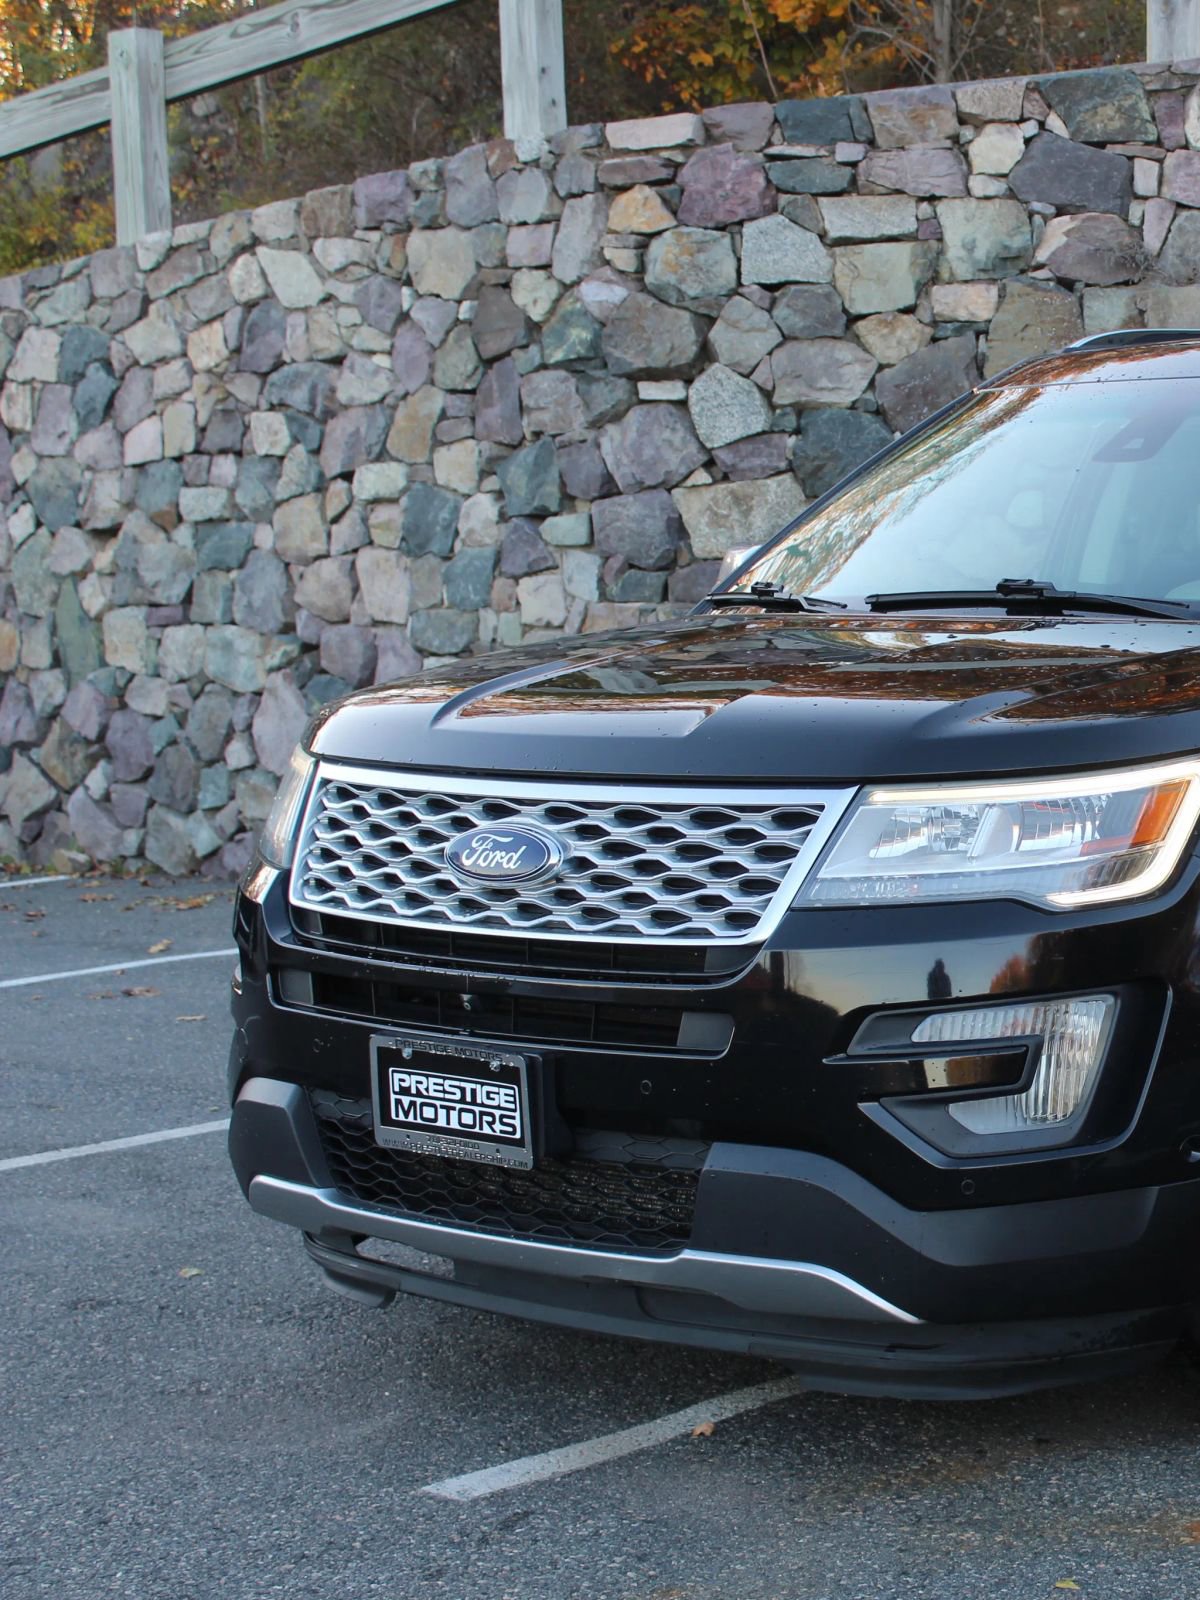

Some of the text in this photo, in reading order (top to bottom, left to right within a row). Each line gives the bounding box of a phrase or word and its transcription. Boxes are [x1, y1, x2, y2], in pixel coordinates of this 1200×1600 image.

[461, 833, 528, 869] Ford
[394, 1038, 503, 1062] PRESTIGE MOTORS
[392, 1071, 516, 1111] PRESTIGE
[393, 1096, 518, 1137] MOTORS
